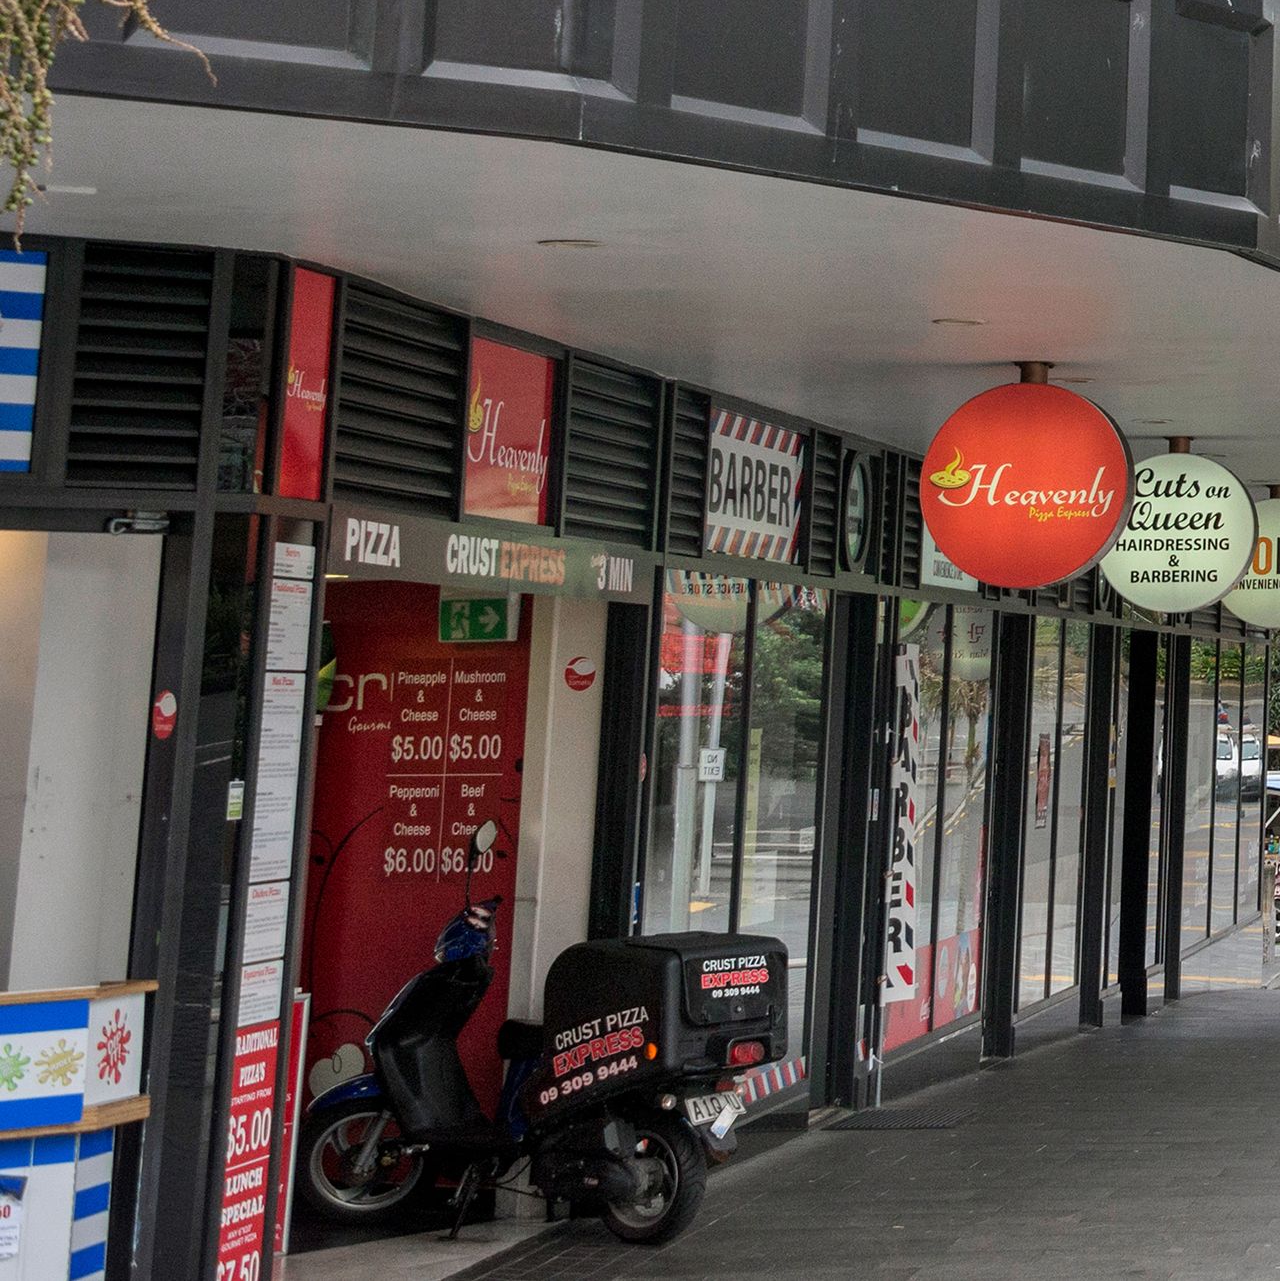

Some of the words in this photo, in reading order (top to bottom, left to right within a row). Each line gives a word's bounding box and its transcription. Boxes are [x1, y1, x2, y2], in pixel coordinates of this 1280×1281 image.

[468, 398, 548, 494] Heavenly
[709, 448, 792, 527] BARBER
[937, 463, 1115, 517] Heavenly
[1135, 468, 1201, 498] Cuts
[1205, 485, 1231, 498] on
[1028, 506, 1054, 522] Pizza
[1057, 506, 1090, 520] Express
[1127, 501, 1225, 531] Queen
[345, 518, 400, 567] PIZZA
[1116, 538, 1229, 551] HAIRDRESSING
[447, 534, 499, 576] CRUST
[501, 541, 566, 585] EXPRESS
[609, 556, 634, 592] MIN
[1168, 554, 1180, 567] &
[1130, 570, 1218, 583] BARBERING
[398, 671, 447, 685] Pineapple
[455, 670, 506, 684] Mushroom
[416, 689, 425, 703] &
[475, 689, 484, 703] &
[401, 708, 439, 722] Cheese
[459, 708, 497, 722] Cheese
[392, 734, 443, 762] $5.00
[450, 734, 501, 762] $5.00
[390, 784, 440, 800] Pepperoni
[461, 784, 486, 797] Beef
[409, 803, 417, 816] &
[467, 803, 475, 816] &
[394, 822, 431, 836] Cheese
[451, 822, 478, 836] Chee
[384, 846, 436, 876] $6.00
[703, 958, 736, 972] CRUST
[738, 955, 767, 969] PIZZA
[701, 968, 769, 989] EXPRESS
[712, 989, 723, 998] 09
[724, 987, 739, 997] 309
[740, 985, 760, 996] 9444
[555, 1018, 602, 1050] CRUST
[606, 1006, 649, 1031] PIZZA
[553, 1026, 644, 1077] EXPRESS
[239, 1062, 266, 1087] PIZZA'S
[540, 1087, 558, 1105] 09
[561, 1072, 594, 1094] 309
[597, 1056, 638, 1080] 9444
[256, 1087, 272, 1099] FROM
[226, 1107, 272, 1164] $5.00
[225, 1166, 264, 1197] LUNCH
[220, 1195, 265, 1228] SPECIAL
